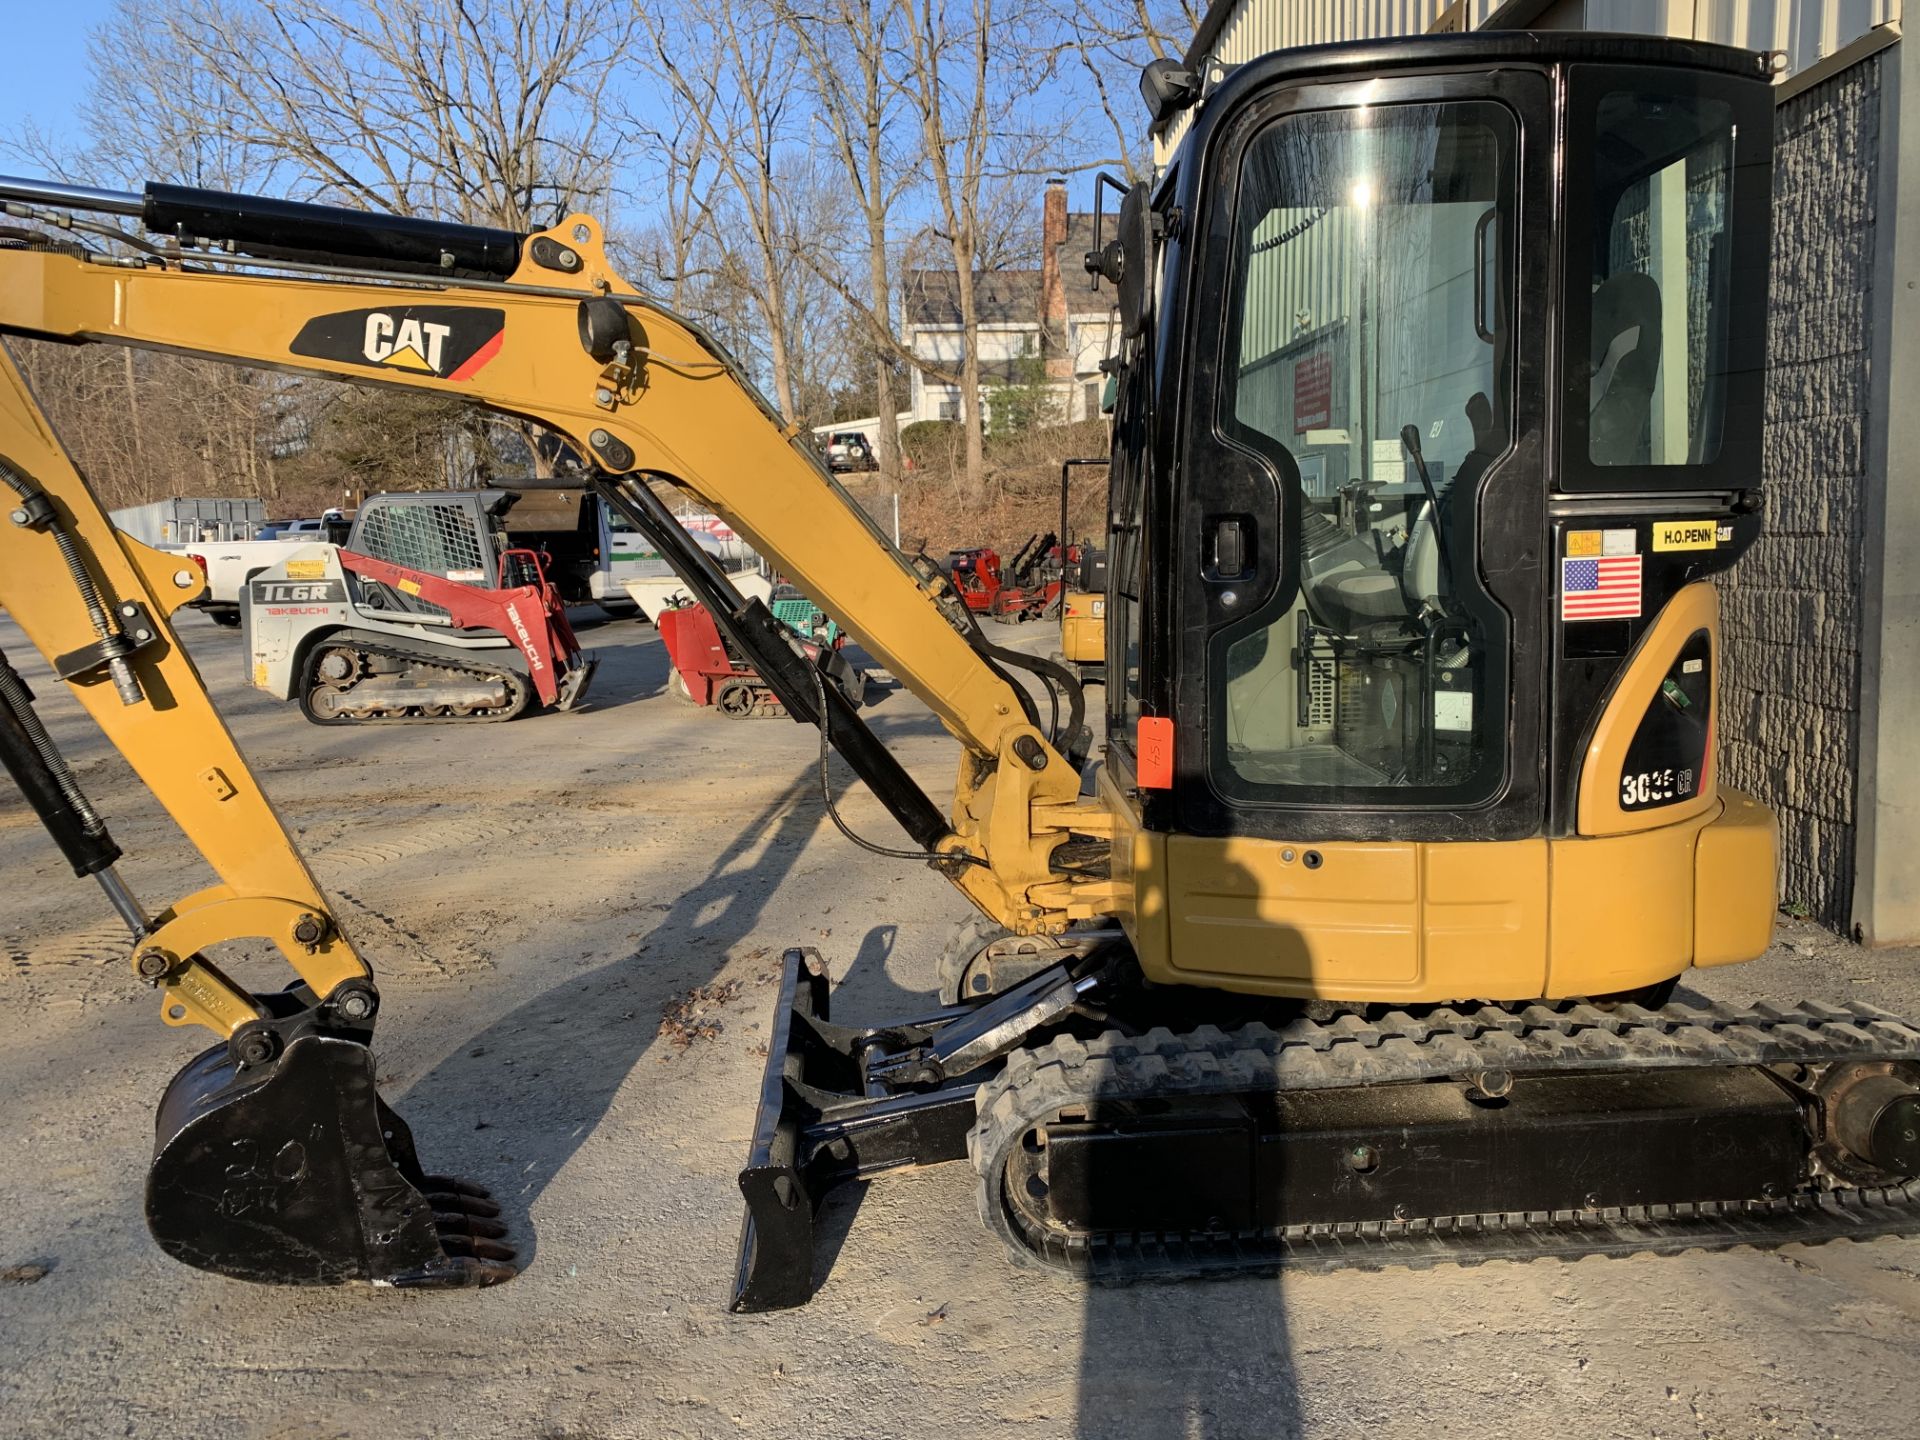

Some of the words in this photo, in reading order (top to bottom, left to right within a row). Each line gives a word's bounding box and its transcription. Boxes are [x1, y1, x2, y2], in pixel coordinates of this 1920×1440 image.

[364, 313, 450, 373] CAT
[1664, 530, 1712, 545] H.O.PENN
[260, 582, 332, 602] TL6R
